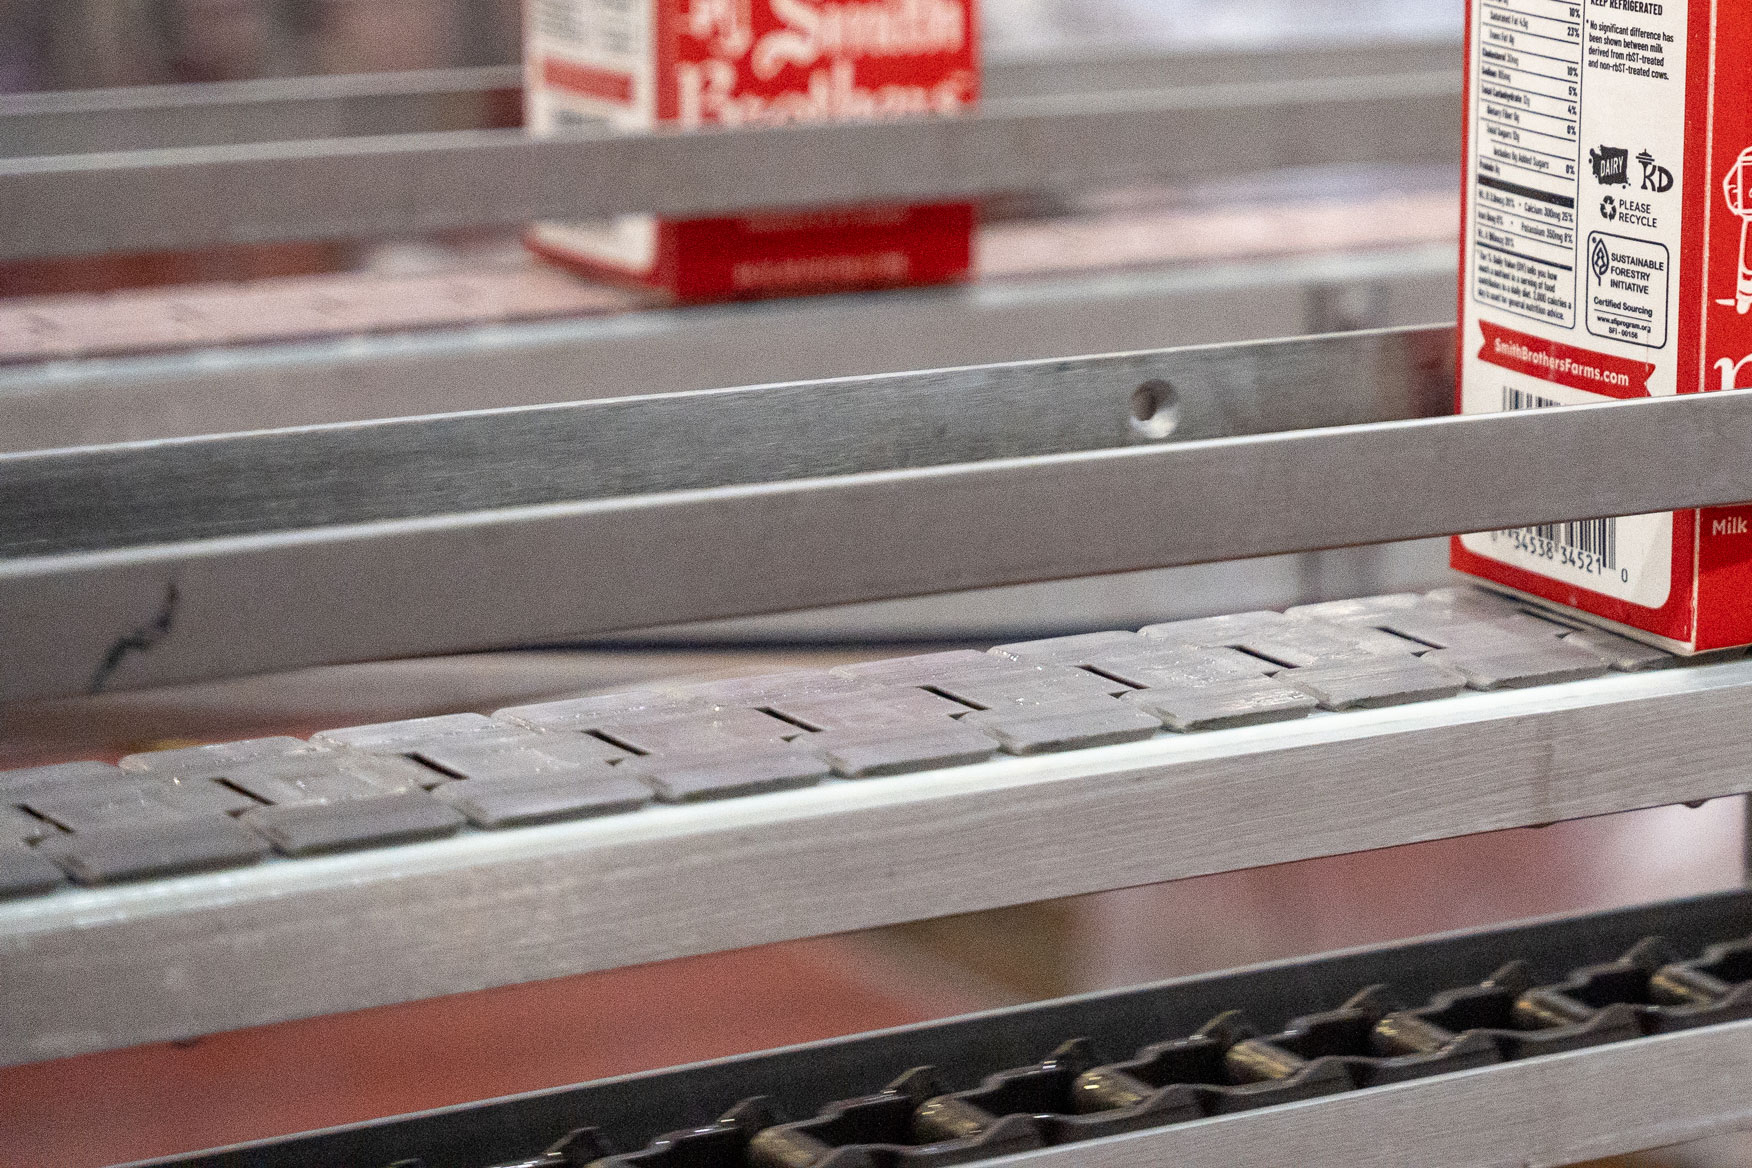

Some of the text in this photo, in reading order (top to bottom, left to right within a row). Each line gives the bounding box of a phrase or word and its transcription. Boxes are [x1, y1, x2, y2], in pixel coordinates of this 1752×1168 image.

[1569, 7, 1580, 18] 10%
[1567, 26, 1580, 38] 23%
[1590, 20, 1674, 43] No significant difference has
[1589, 33, 1663, 54] been shown between milk
[1588, 45, 1664, 67] derived from rbST-treated
[1588, 59, 1669, 81] and non-rbST-treated cows.
[1600, 156, 1624, 177] DAIRY
[1619, 199, 1651, 214] PLEASE
[1619, 212, 1657, 228] RECYCLE
[1611, 252, 1664, 271] SUSTAINABLE
[1610, 266, 1651, 282] FORESTRY
[1610, 279, 1649, 295] INITIATIVE
[1593, 296, 1653, 318] Certified Sourcing
[1597, 316, 1651, 333] www.sfiprogram.org
[1494, 338, 1629, 386] SmithBrothersFarms.com
[1712, 516, 1748, 536] Milk
[1561, 545, 1602, 575] 34521
[1621, 568, 1628, 583] 0
